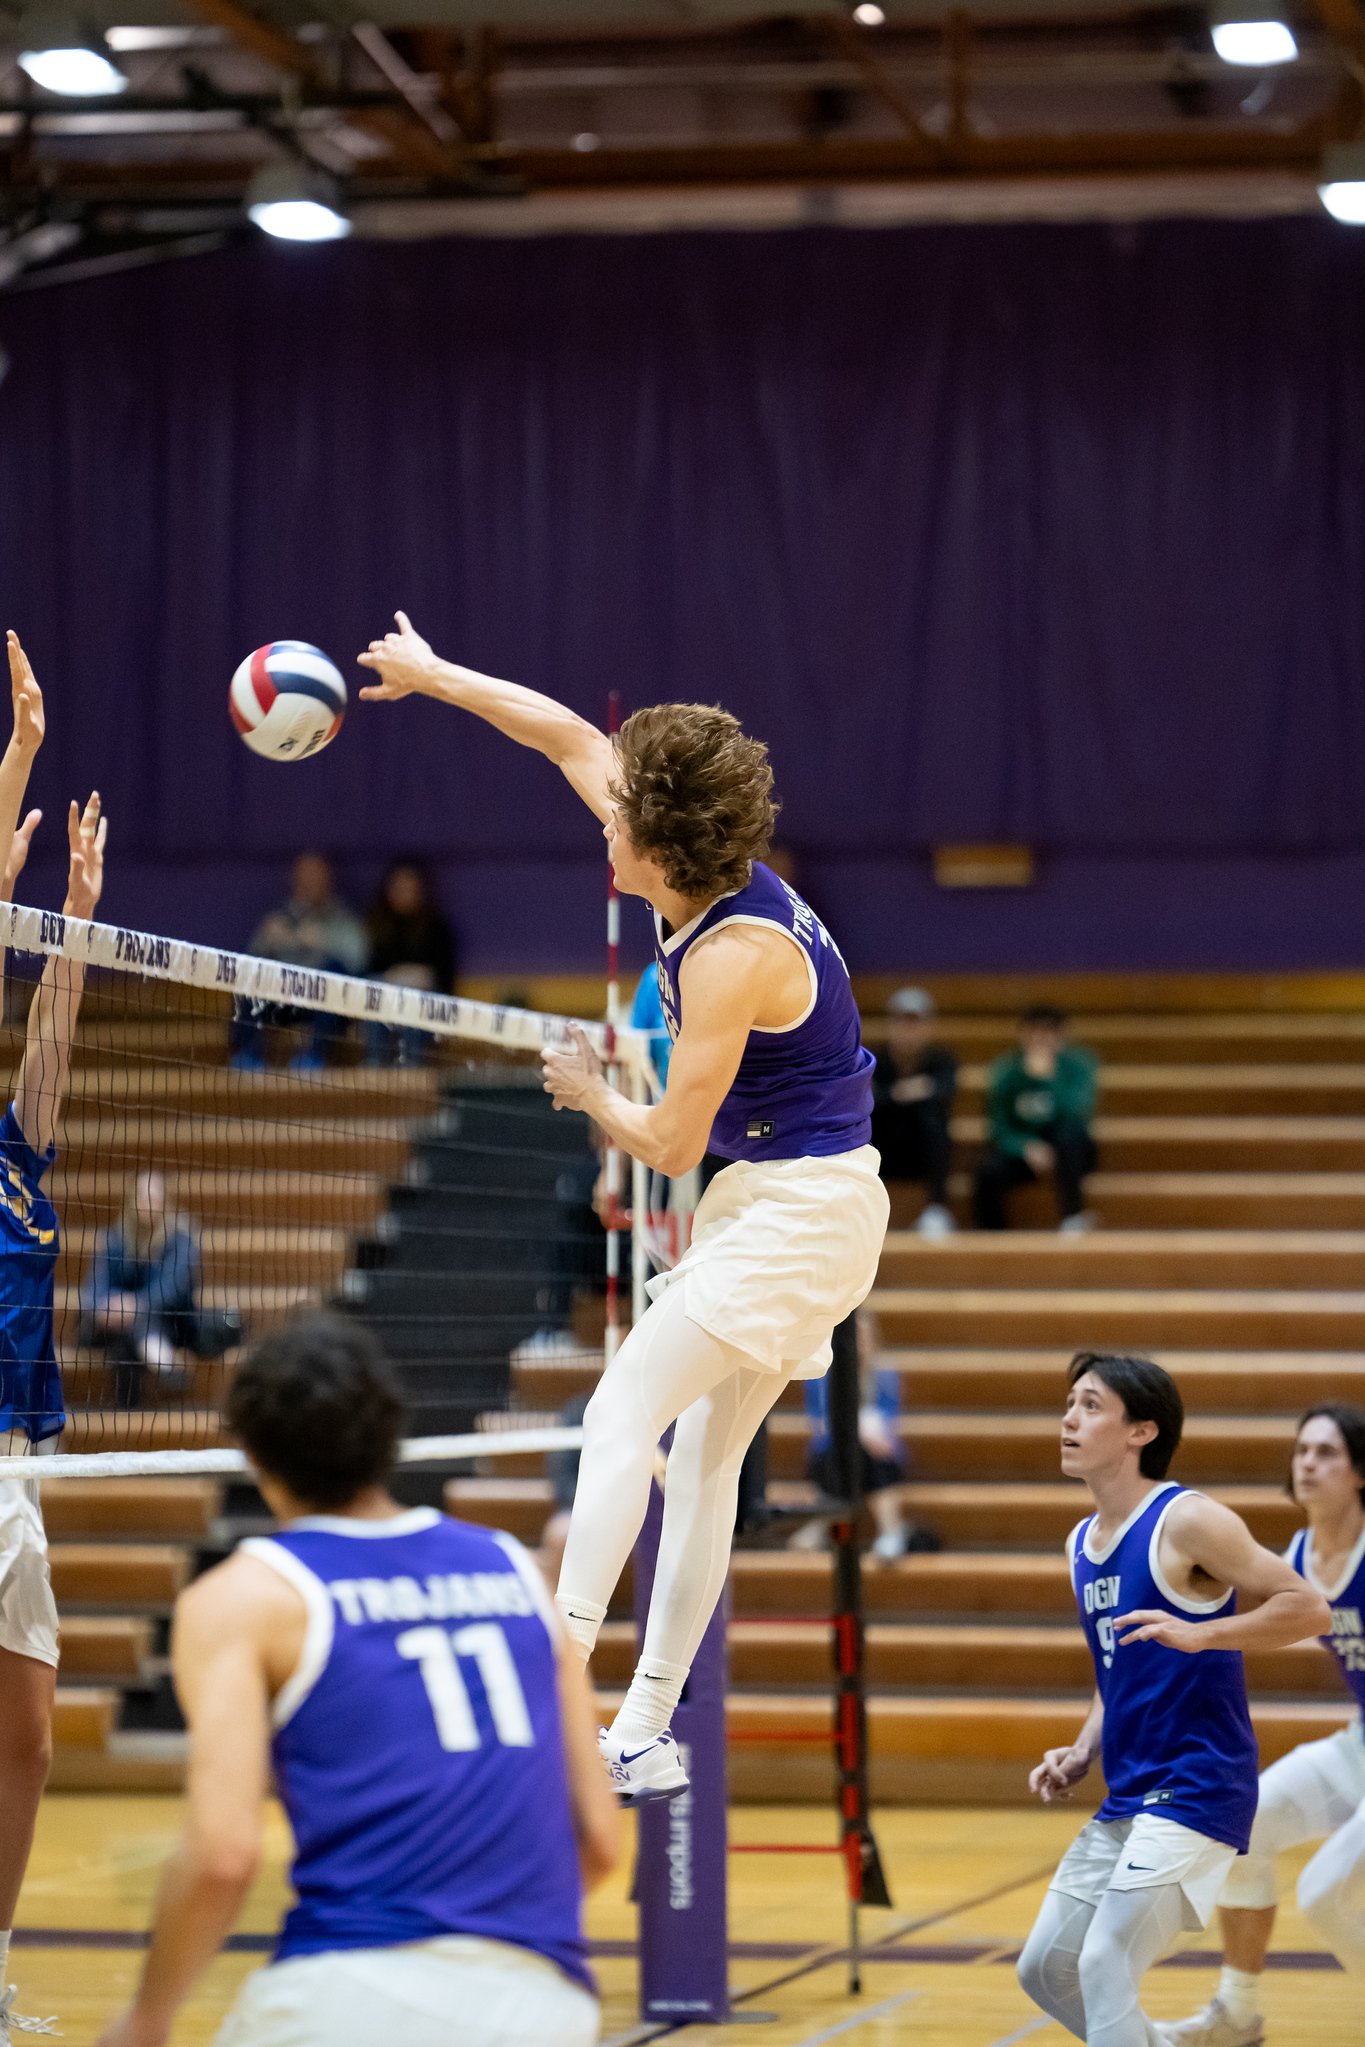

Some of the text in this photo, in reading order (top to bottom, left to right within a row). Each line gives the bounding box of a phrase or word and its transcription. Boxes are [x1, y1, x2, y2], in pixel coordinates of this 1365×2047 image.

[115, 929, 171, 970] TROJANS
[329, 1571, 536, 1626] TROJANS
[1083, 1574, 1122, 1616] DGN
[1095, 1616, 1116, 1670] 9
[1331, 1607, 1363, 1636] GN
[395, 1622, 536, 1753] 11
